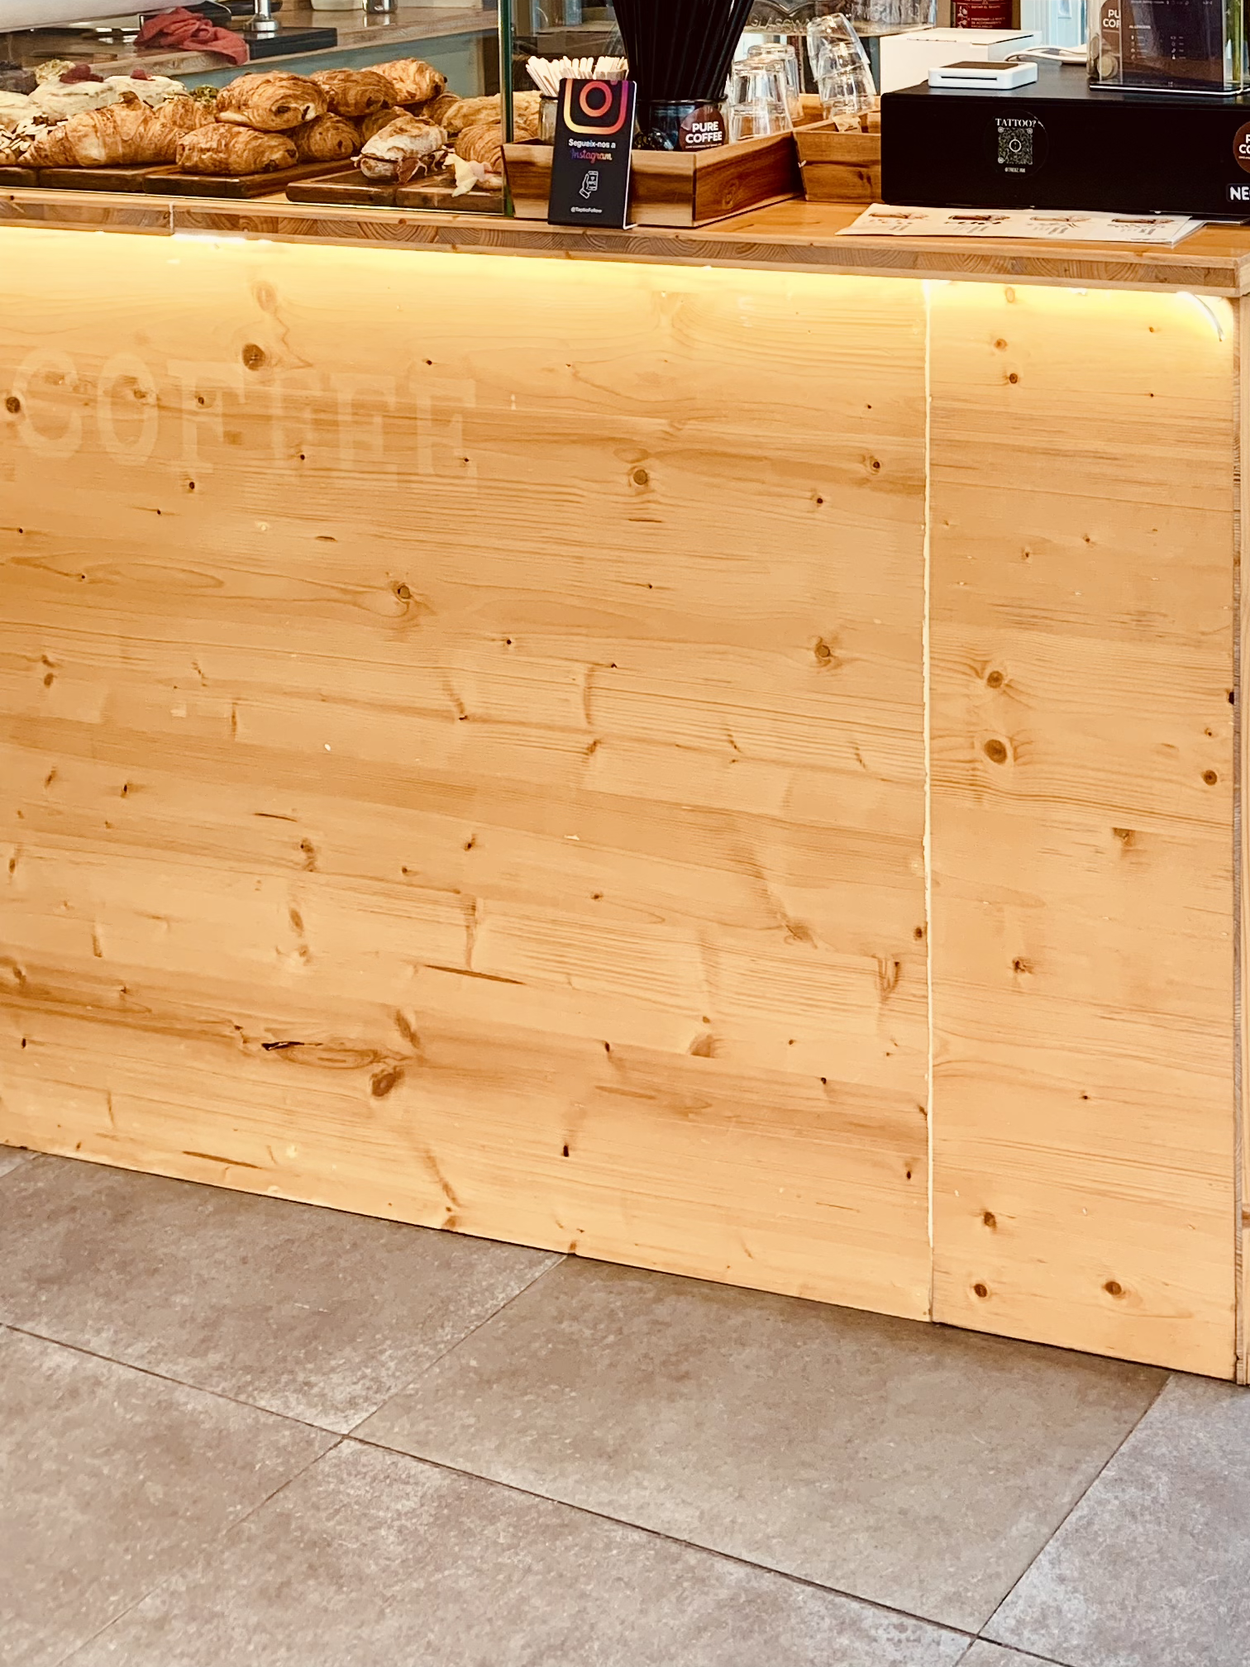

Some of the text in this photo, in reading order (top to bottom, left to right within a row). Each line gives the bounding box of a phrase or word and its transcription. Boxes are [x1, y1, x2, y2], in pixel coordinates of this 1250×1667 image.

[692, 121, 719, 134] PURE
[995, 117, 1037, 128] TATTOO?
[685, 131, 723, 144] COFFEE
